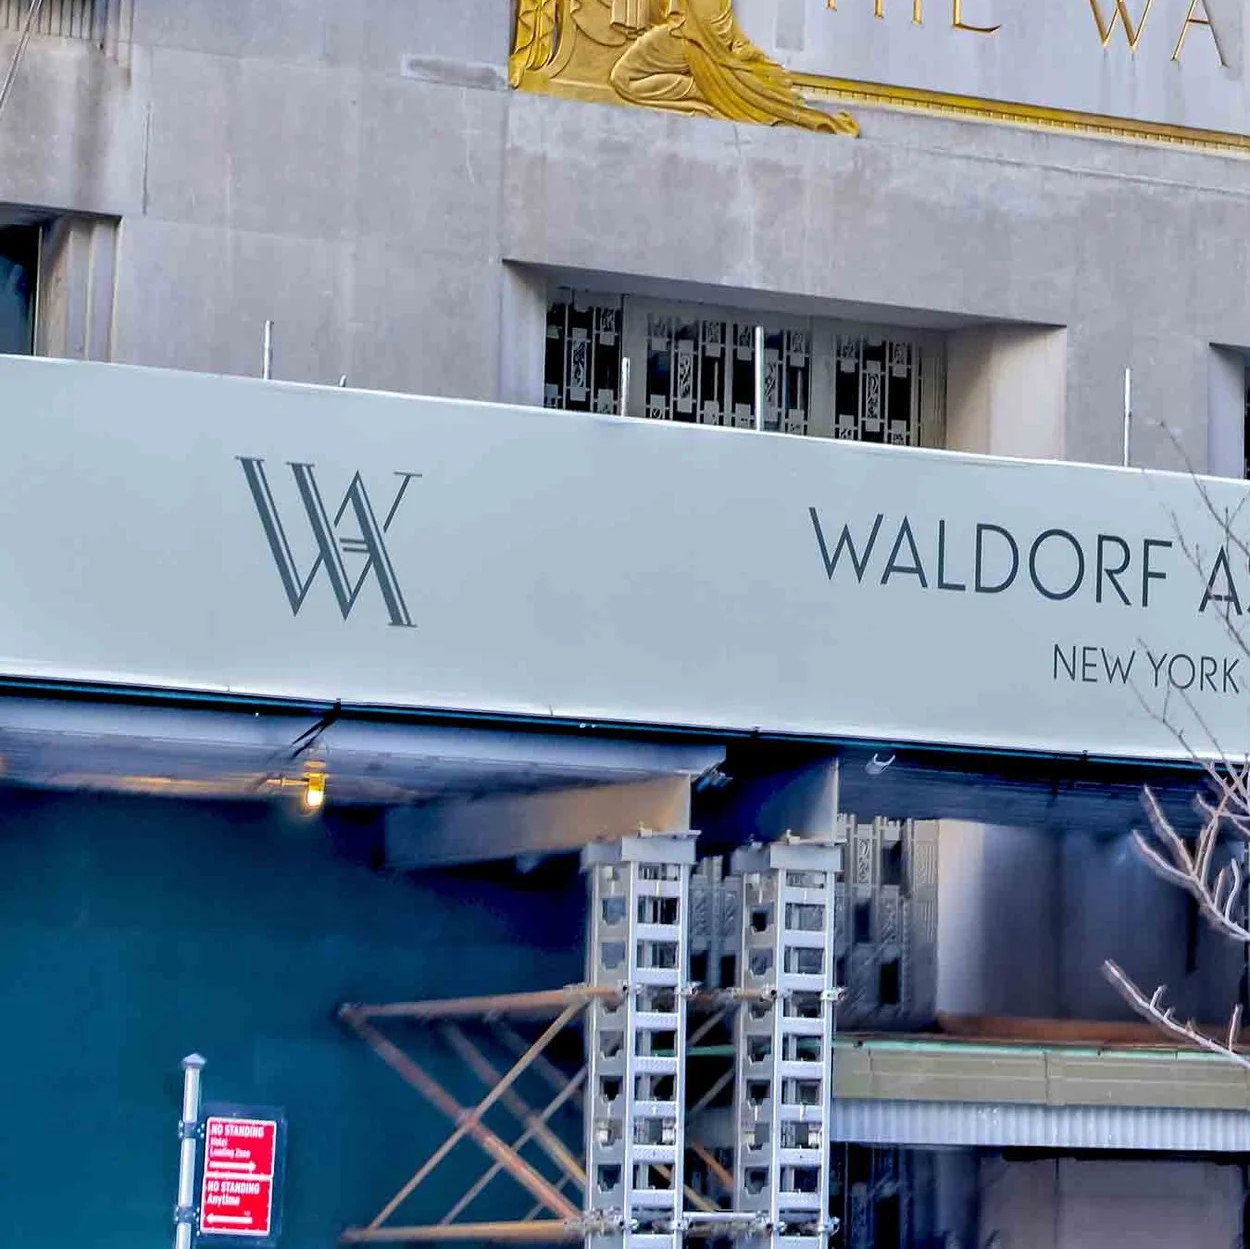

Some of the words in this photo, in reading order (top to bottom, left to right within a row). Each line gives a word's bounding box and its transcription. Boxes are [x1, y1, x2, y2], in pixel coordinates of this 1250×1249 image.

[808, 506, 1173, 608] WALDORF
[1052, 643, 1136, 686] NEW
[1146, 649, 1241, 694] YORK
[211, 1123, 223, 1136] NO
[224, 1124, 264, 1138] STANDING
[209, 1148, 234, 1159] Loading
[207, 1180, 220, 1193] NO
[220, 1181, 260, 1194] STANDING
[206, 1193, 240, 1207] Anytime
